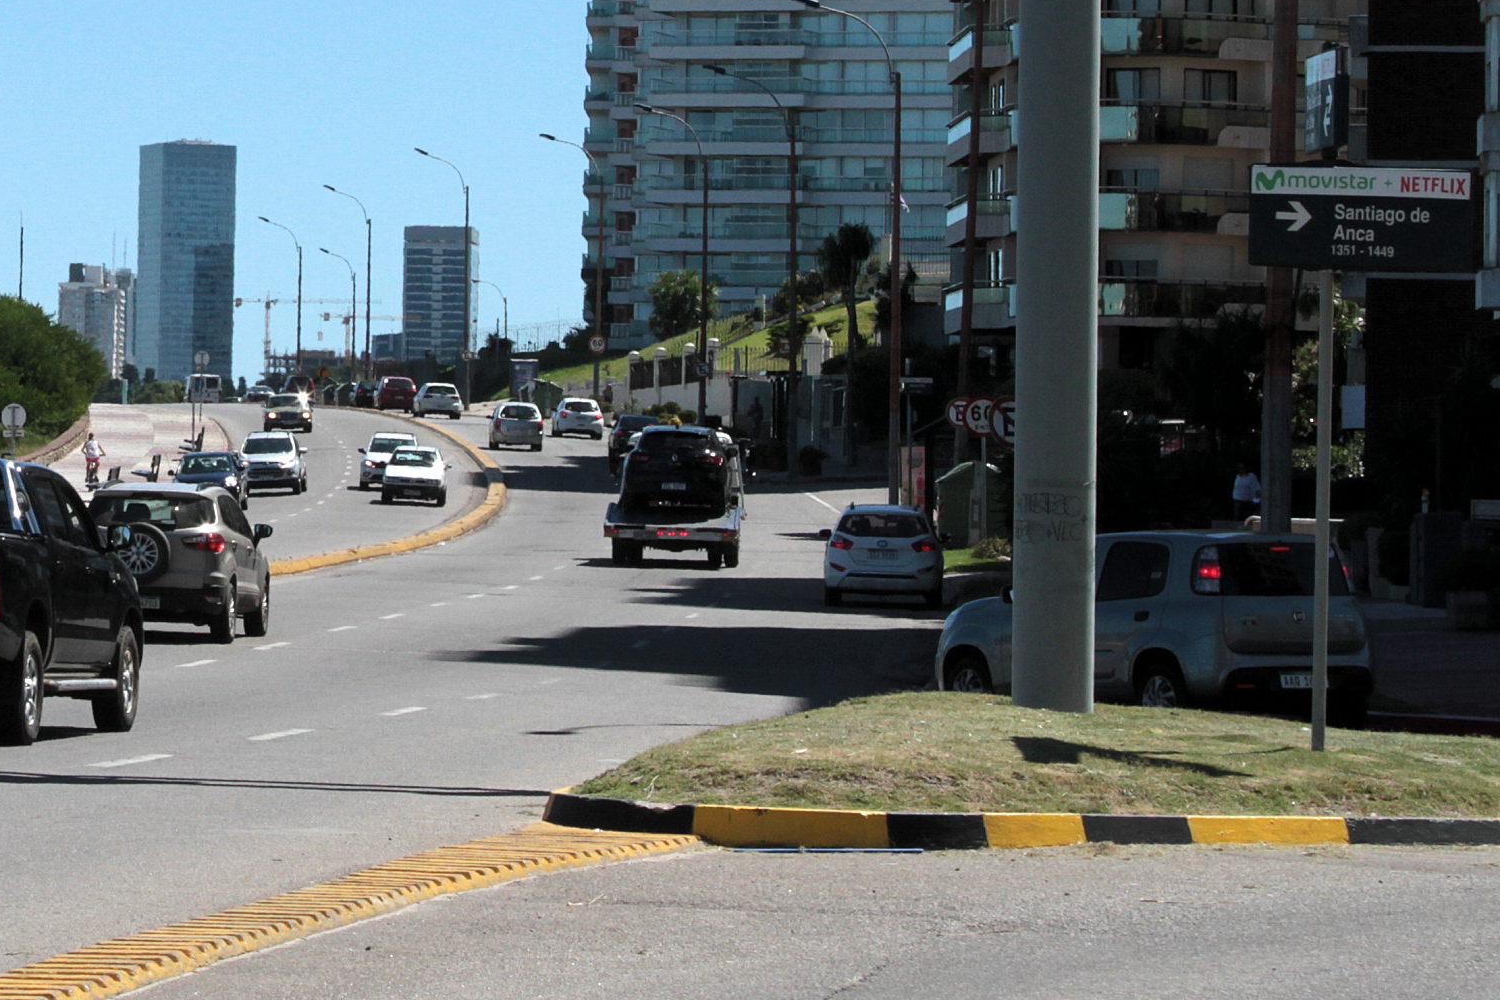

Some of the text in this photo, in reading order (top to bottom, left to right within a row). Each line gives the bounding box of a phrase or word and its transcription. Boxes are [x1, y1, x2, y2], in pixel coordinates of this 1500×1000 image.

[1287, 174, 1377, 190] movistar
[1400, 176, 1466, 196] NETFLIX
[1334, 204, 1431, 225] Santiago de
[1333, 225, 1375, 242] Anca
[1331, 245, 1356, 256] 1351
[1367, 246, 1395, 257] 1449
